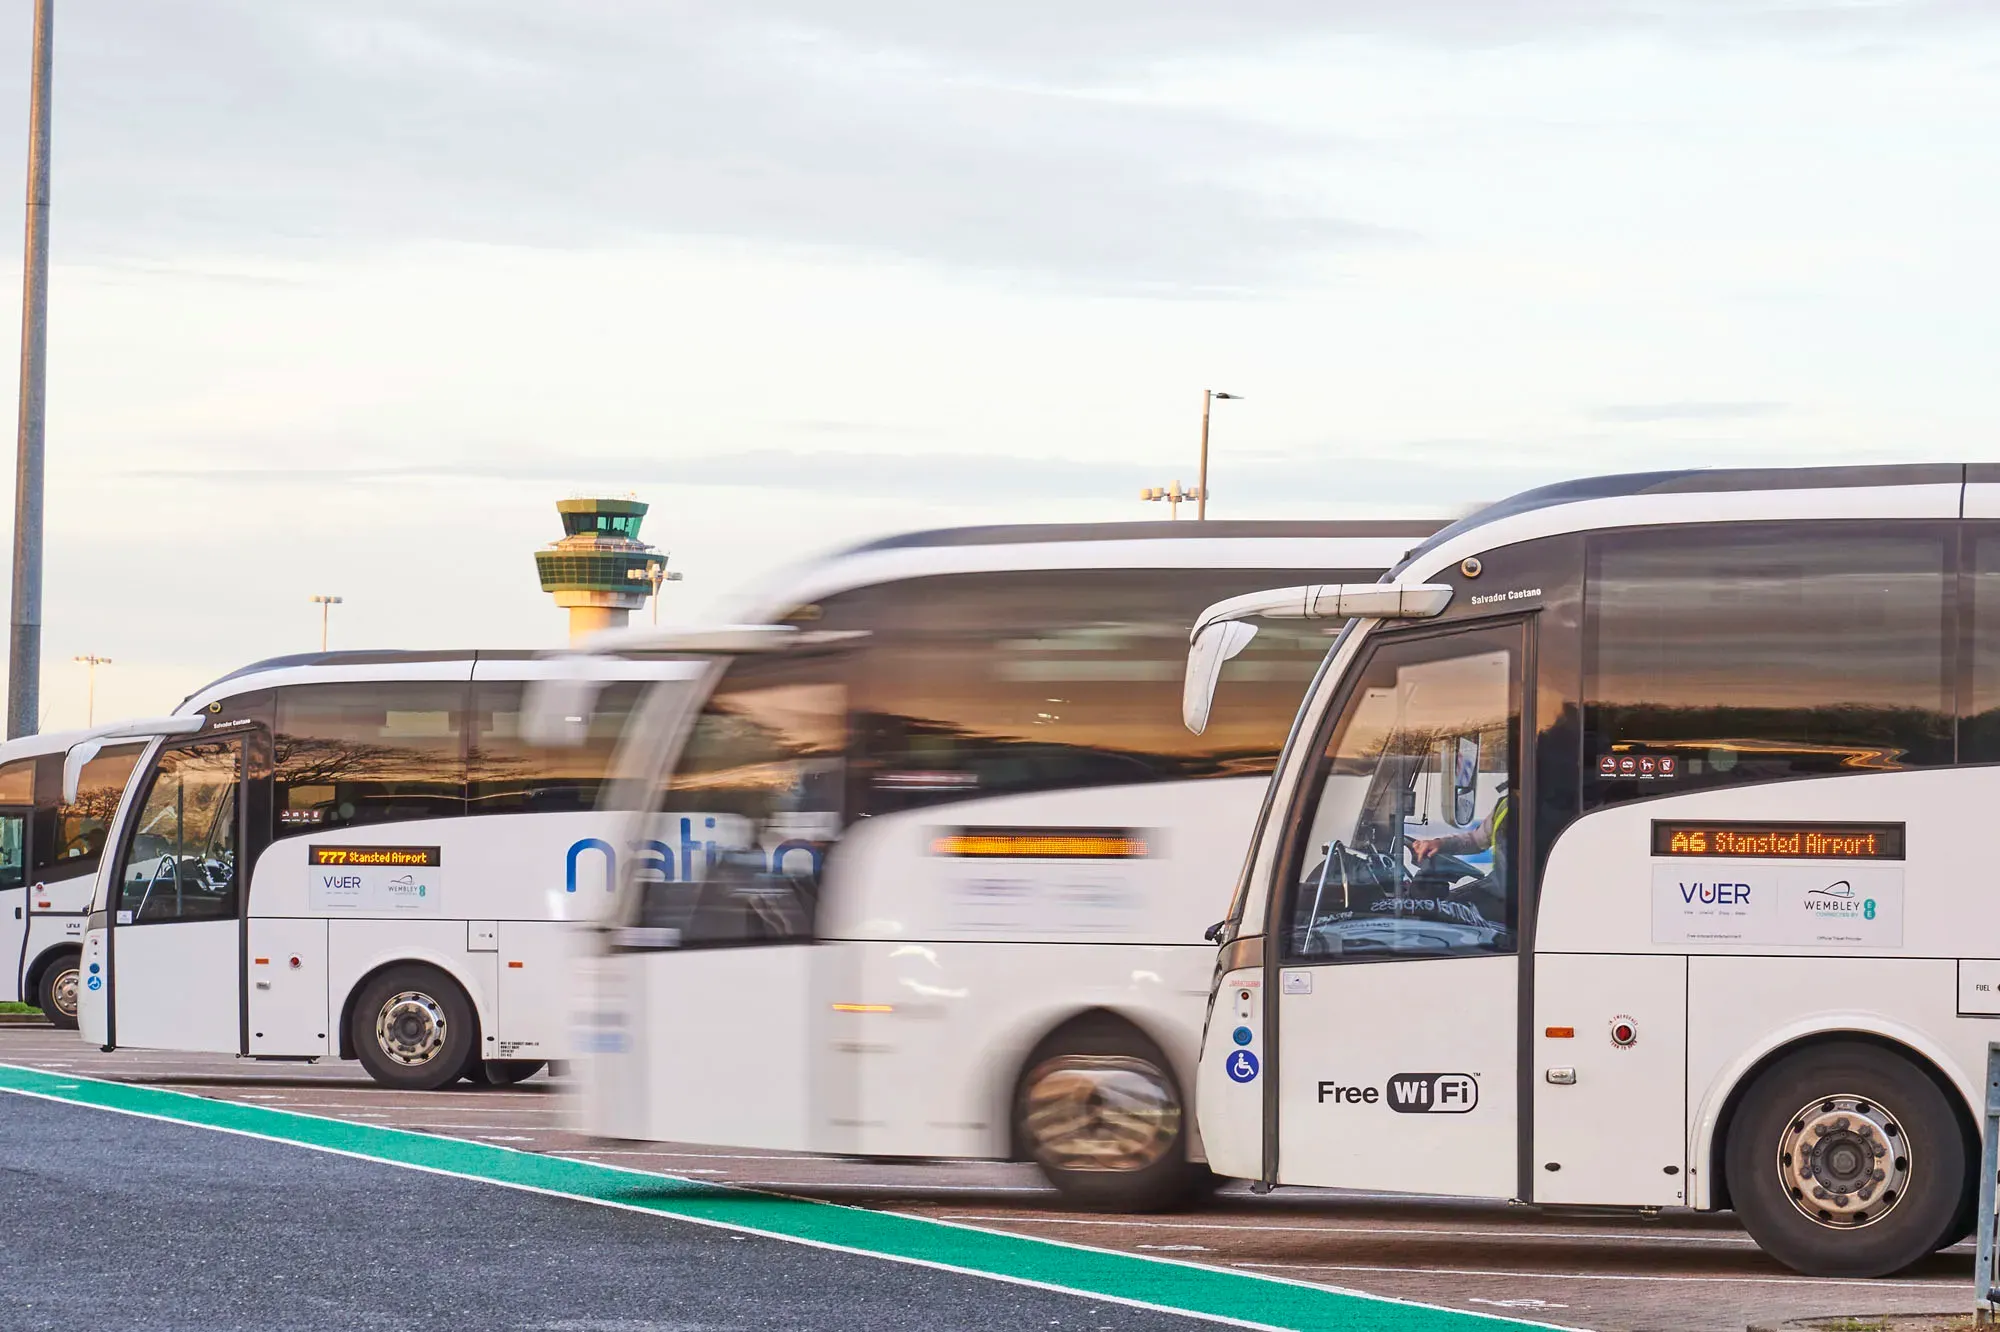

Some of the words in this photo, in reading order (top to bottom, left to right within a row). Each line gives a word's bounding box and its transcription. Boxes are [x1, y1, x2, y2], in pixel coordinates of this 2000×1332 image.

[1471, 593, 1506, 605] Salvador
[1507, 588, 1542, 600] Caetano
[1671, 831, 1706, 852] A6
[1715, 832, 1799, 853] Stansted
[1806, 833, 1876, 855] Airport
[318, 851, 347, 864] 777
[349, 851, 390, 864] Stansted
[391, 852, 427, 864] Airport
[323, 876, 361, 889] VUER
[388, 885, 418, 893] WEMBLEY
[1679, 882, 1751, 905] VUER
[1803, 900, 1860, 911] WEMBLEY
[1975, 984, 1991, 992] FUEL
[1318, 1081, 1379, 1103] Free
